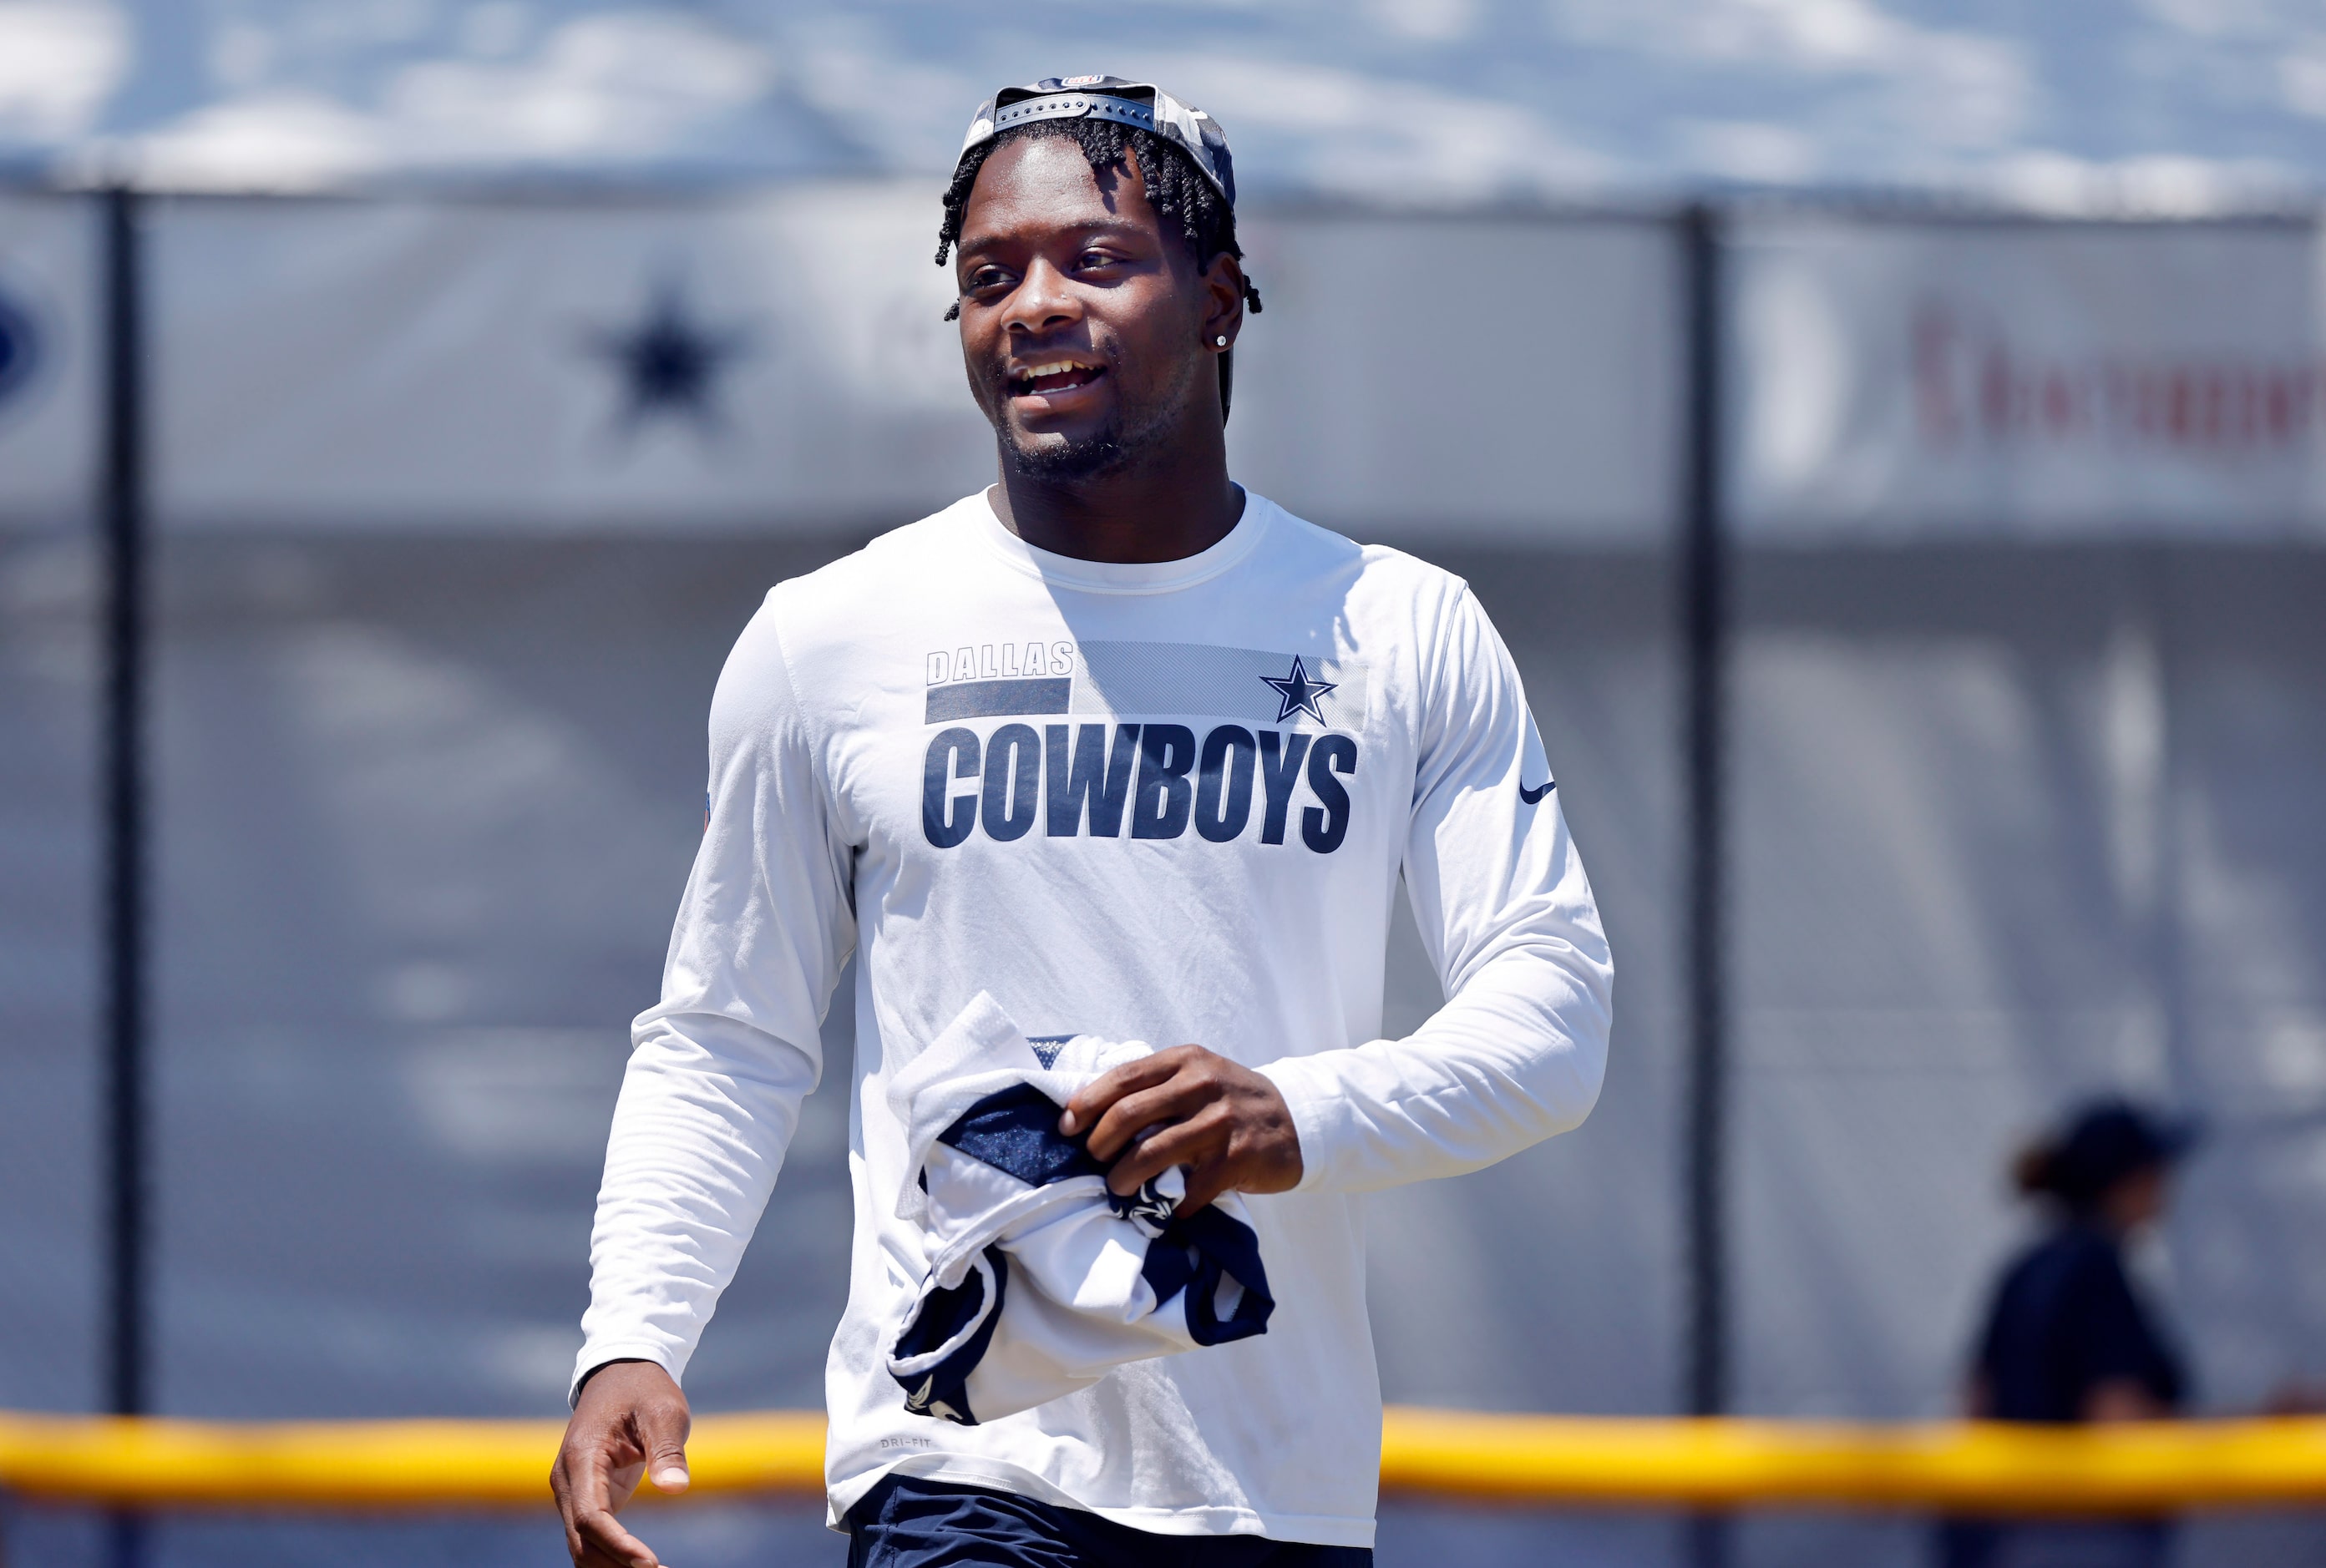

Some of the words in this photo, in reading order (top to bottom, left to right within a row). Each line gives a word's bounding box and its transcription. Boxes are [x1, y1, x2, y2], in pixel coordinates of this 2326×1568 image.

[927, 641, 1073, 685] DALLAS
[922, 723, 1358, 854] COWBOYS
[880, 1438, 931, 1449] DRI-FIT
